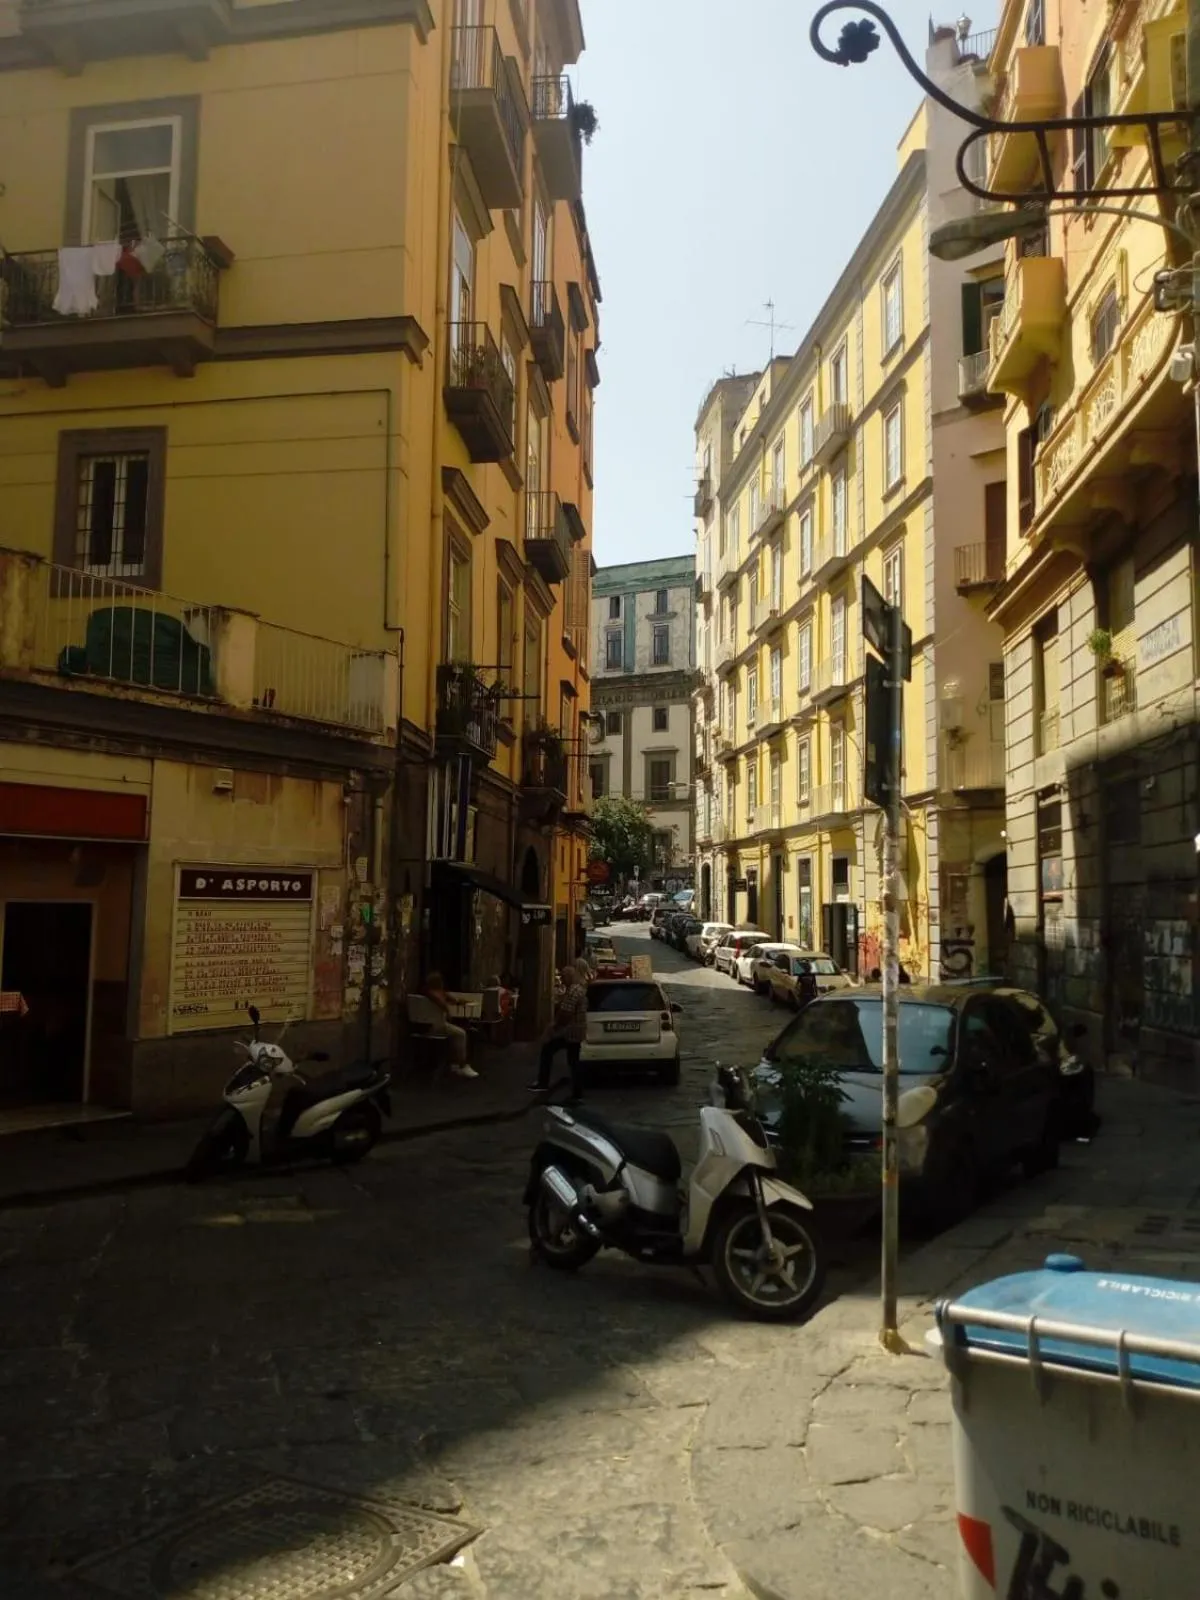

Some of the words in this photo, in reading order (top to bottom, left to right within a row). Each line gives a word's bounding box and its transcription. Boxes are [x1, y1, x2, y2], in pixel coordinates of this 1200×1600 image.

[222, 879, 302, 892] ASPORTO
[1026, 1489, 1061, 1517] NON
[1067, 1500, 1182, 1548] RICICLABILE
